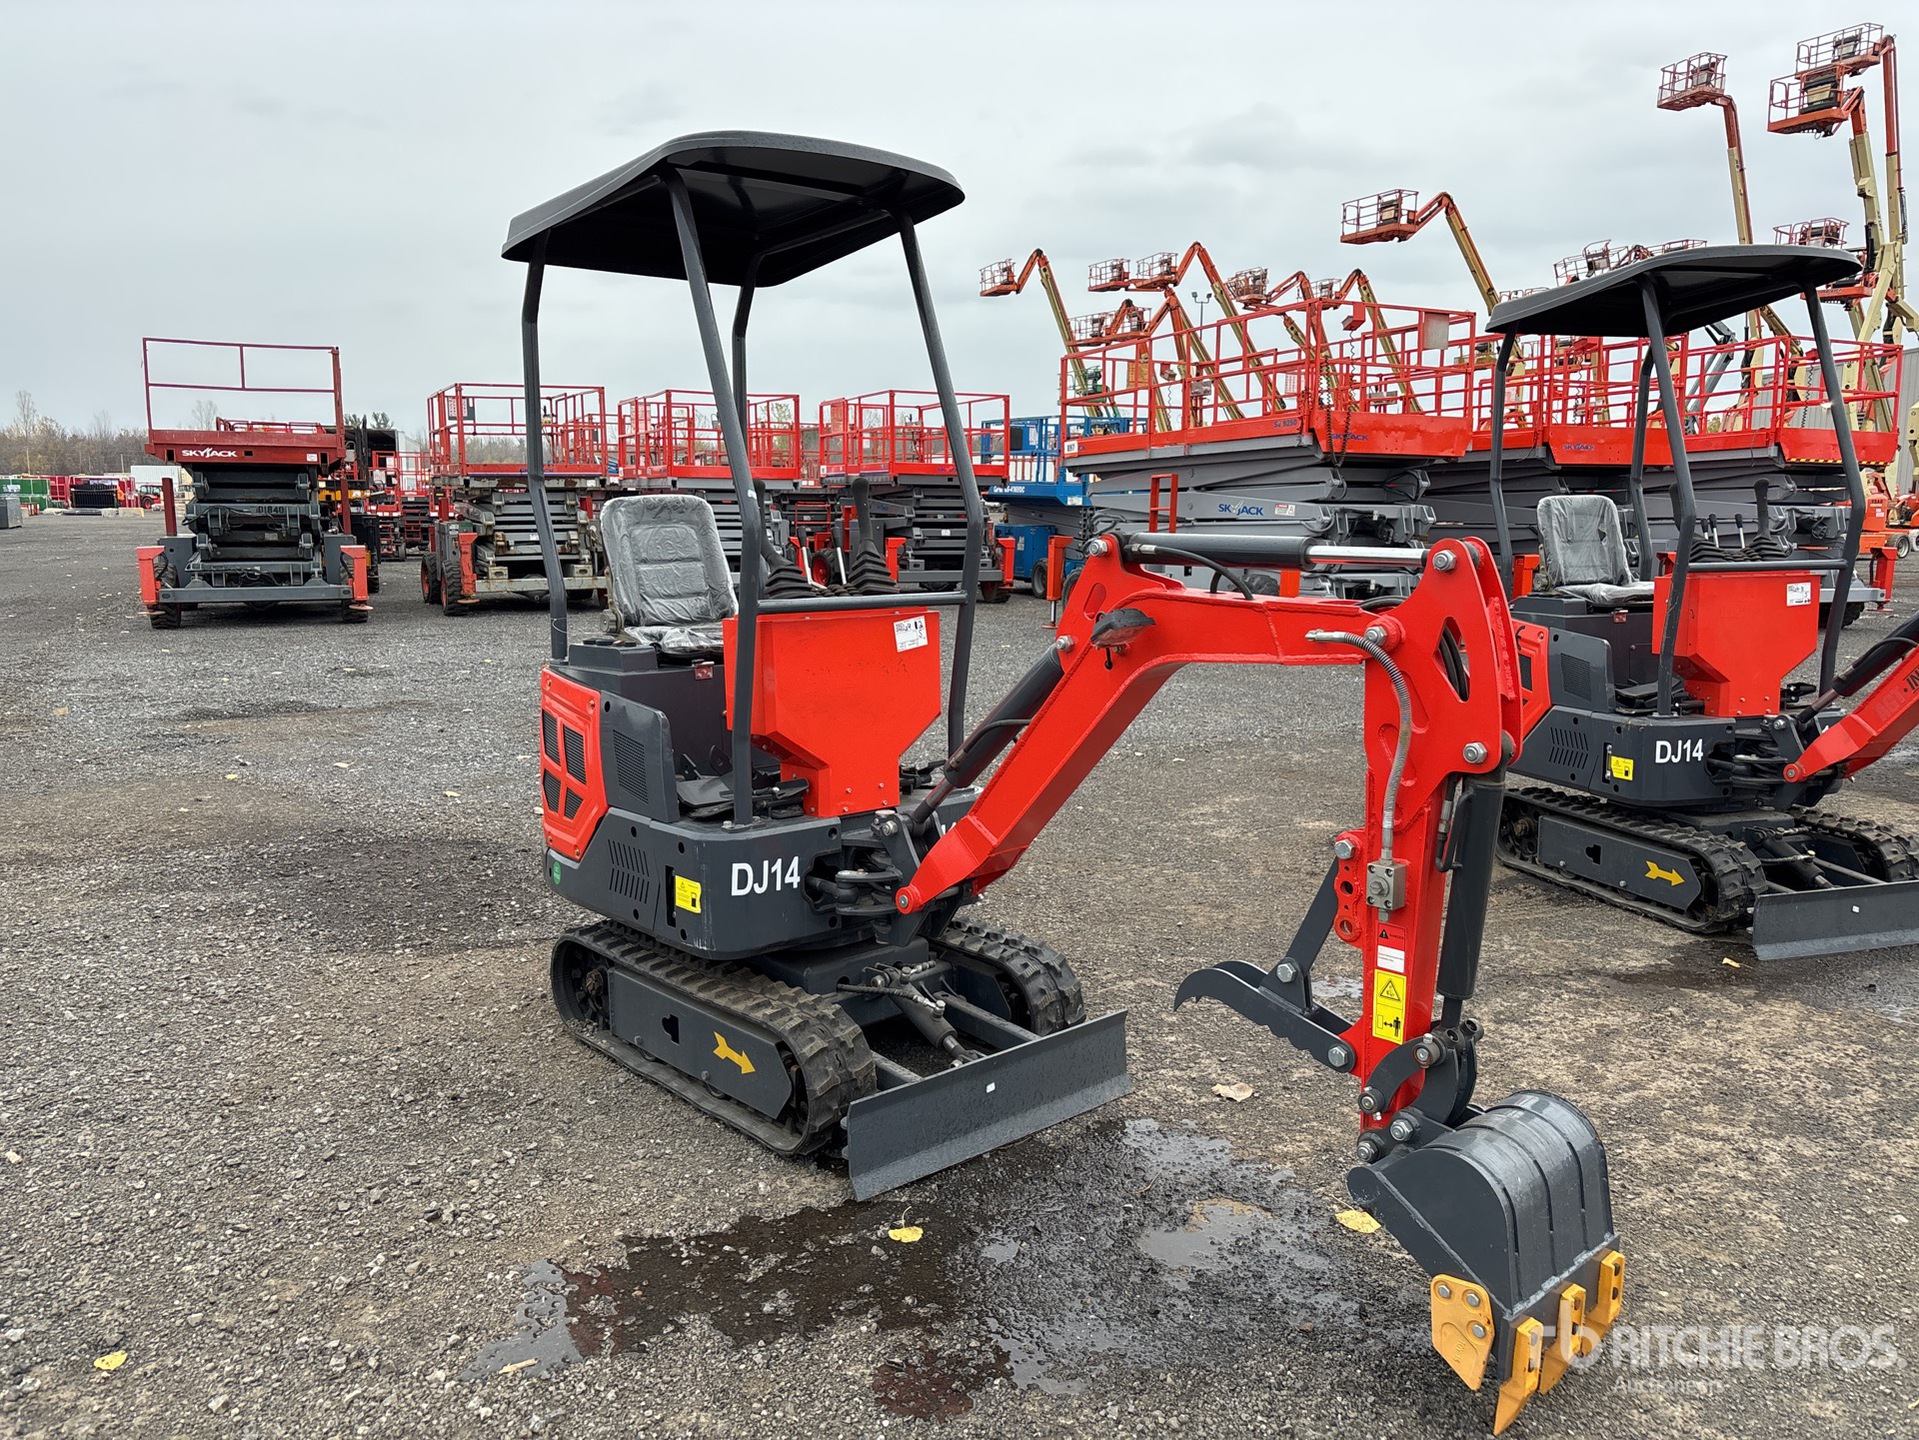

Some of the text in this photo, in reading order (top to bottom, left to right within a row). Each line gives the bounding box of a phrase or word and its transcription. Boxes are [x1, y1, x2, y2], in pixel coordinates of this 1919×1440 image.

[182, 447, 237, 458] SKYJACK
[1218, 500, 1264, 516] SKYJACK
[1655, 738, 1704, 764] DJ14
[731, 856, 801, 896] DJ14
